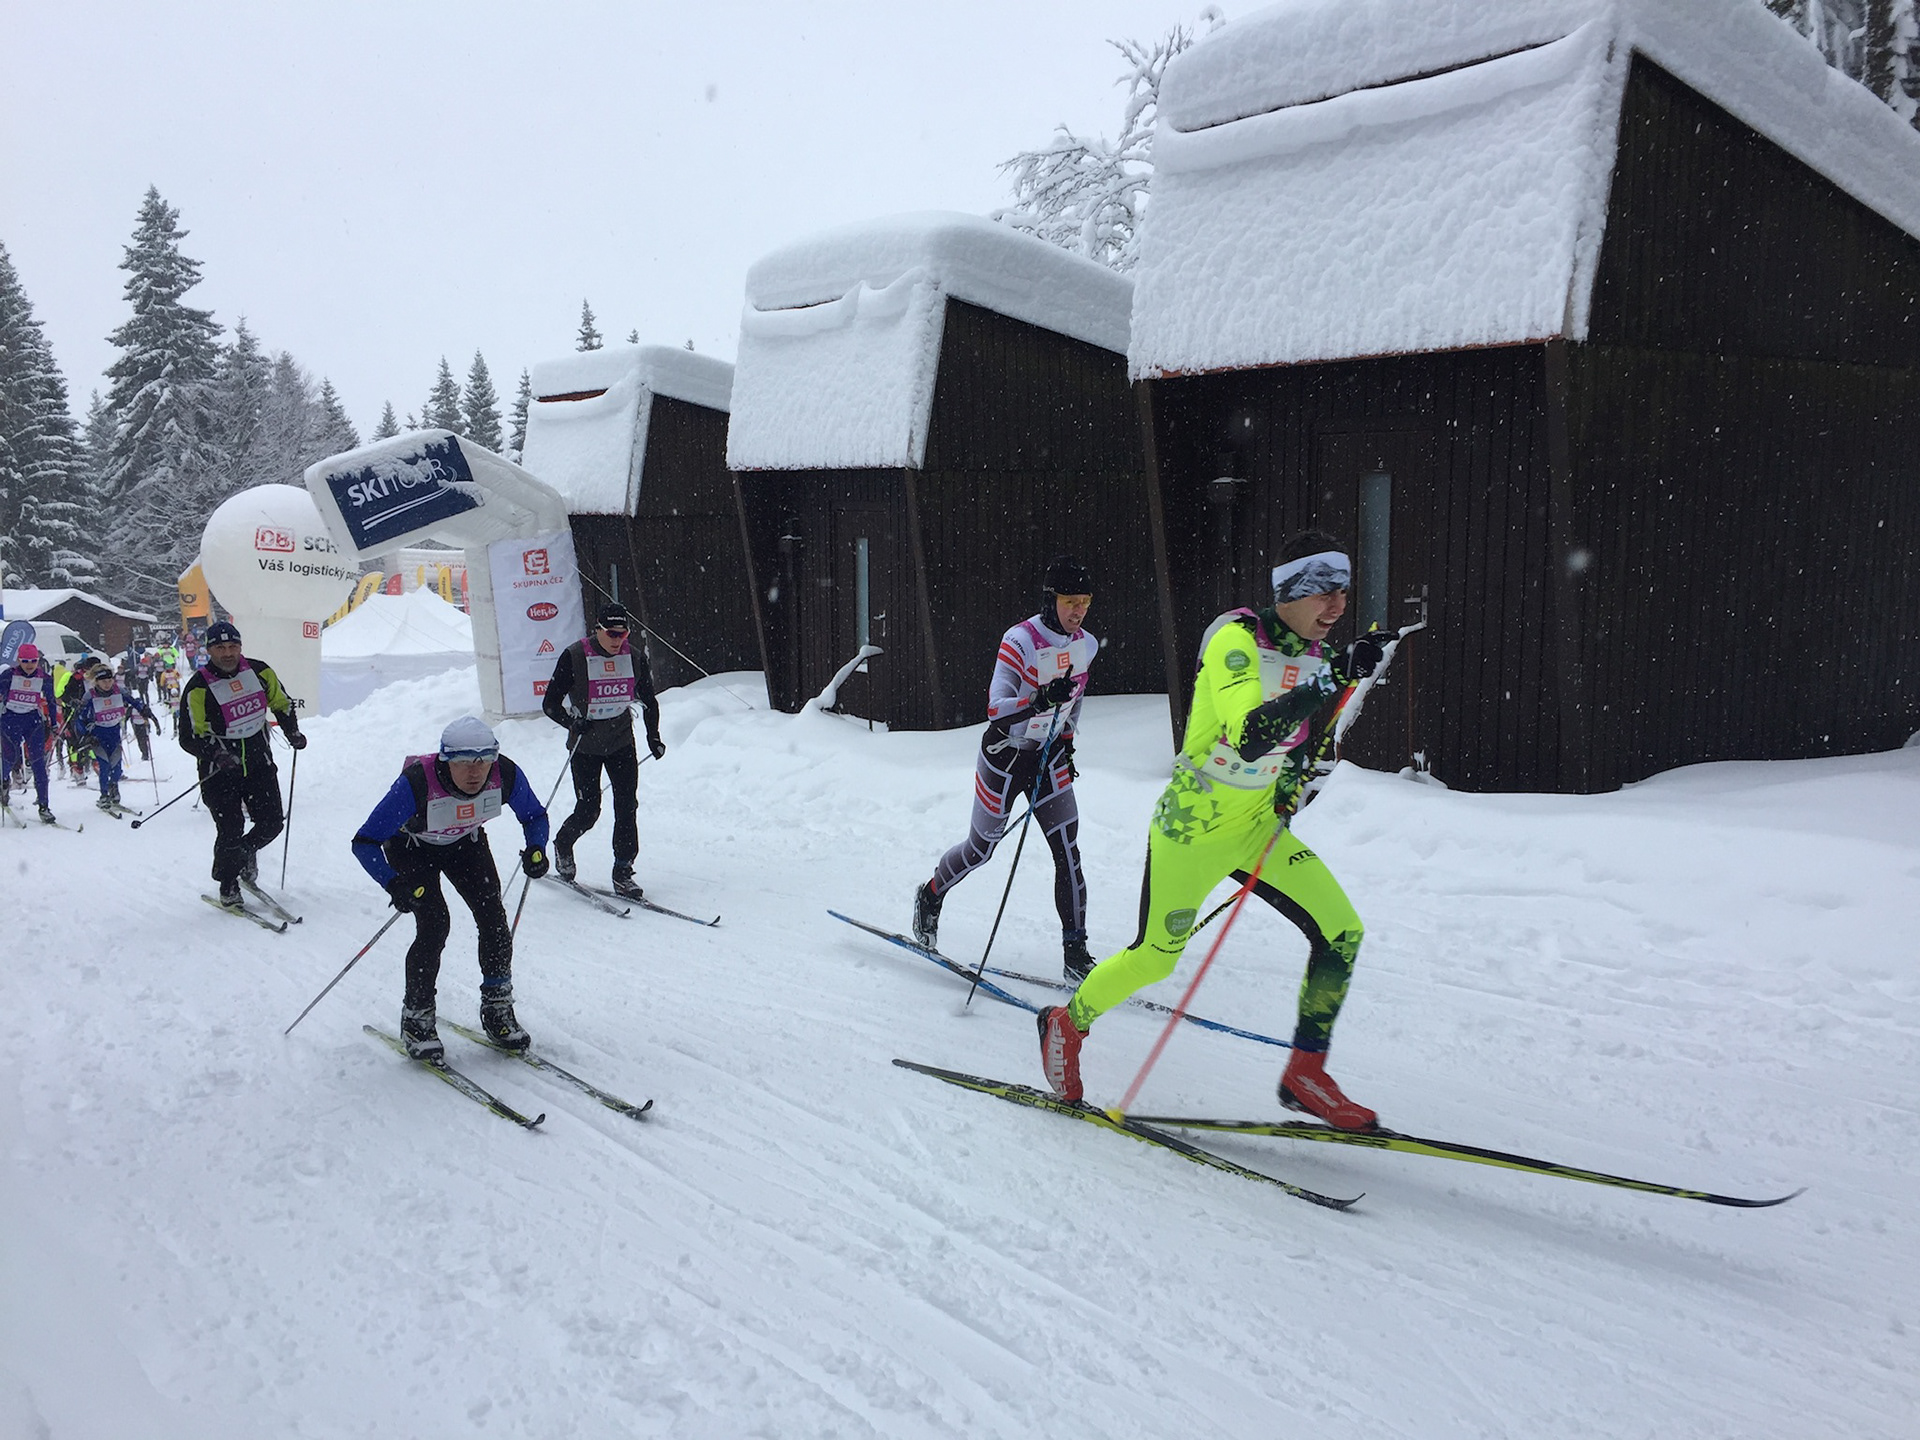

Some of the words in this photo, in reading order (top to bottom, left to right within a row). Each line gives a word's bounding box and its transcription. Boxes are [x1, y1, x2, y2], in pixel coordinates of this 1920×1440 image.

[258, 558, 285, 572] Váš
[289, 561, 346, 581] logistický
[512, 579, 548, 589] SKUPINA
[549, 576, 564, 585] ČEZ
[529, 606, 558, 618] Hervis
[305, 624, 318, 636] DB
[596, 683, 628, 696] 1063
[14, 692, 37, 703] 1028
[229, 698, 261, 719] 1023
